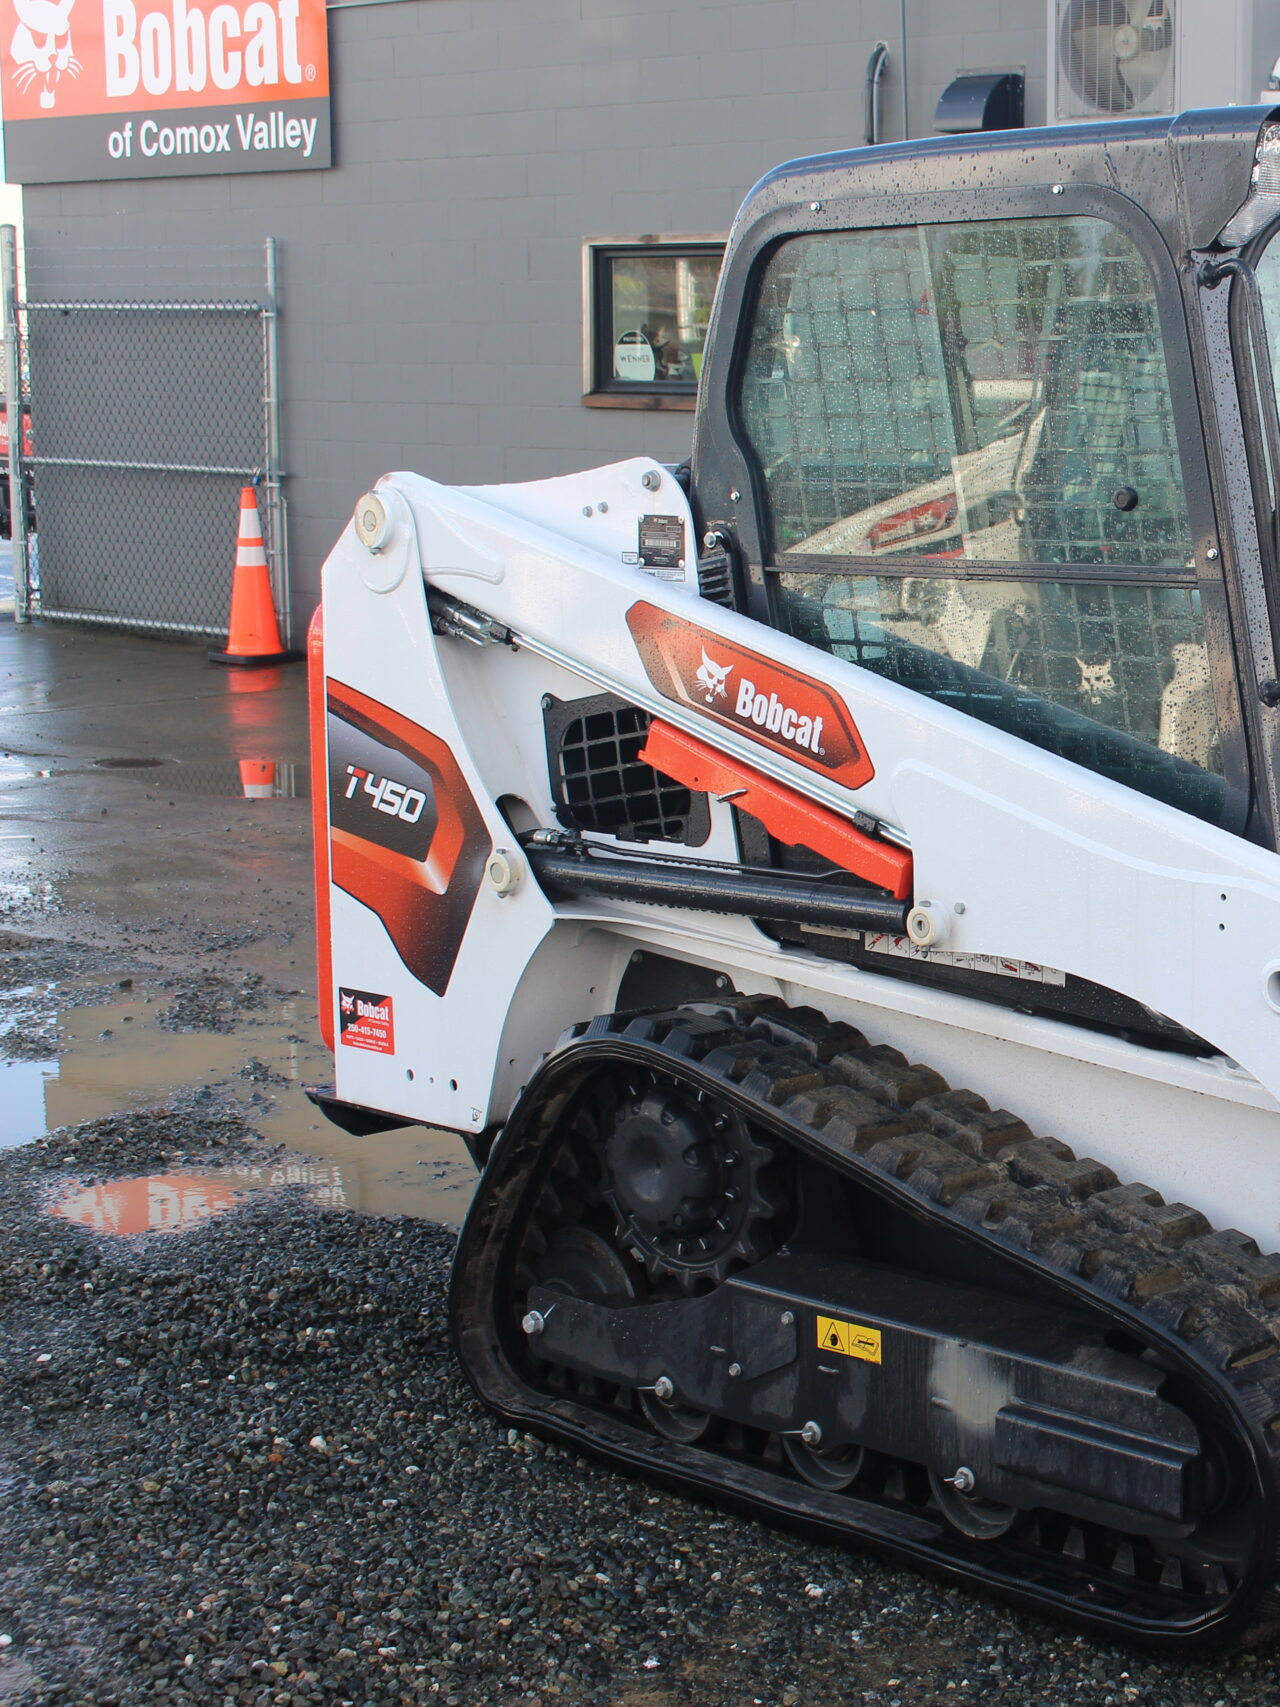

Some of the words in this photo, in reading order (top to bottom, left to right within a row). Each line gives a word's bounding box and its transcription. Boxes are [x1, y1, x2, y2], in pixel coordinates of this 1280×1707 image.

[103, 0, 303, 97] Bobcat
[107, 122, 133, 158] of
[140, 120, 231, 157] Comox
[236, 112, 317, 157] Valley
[735, 678, 824, 754] Bobcat
[345, 764, 427, 824] T450
[357, 999, 390, 1022] Bobcat
